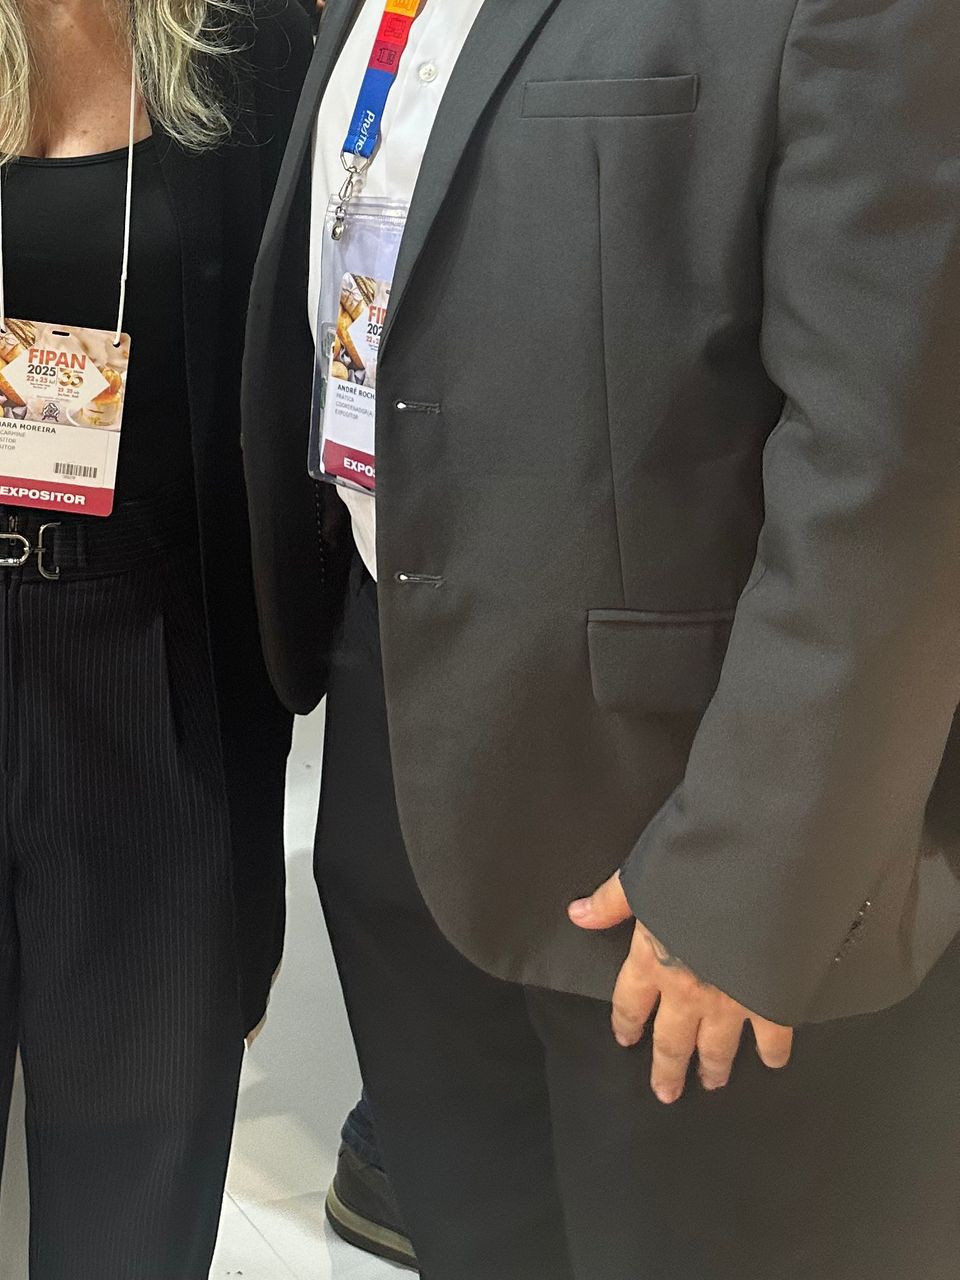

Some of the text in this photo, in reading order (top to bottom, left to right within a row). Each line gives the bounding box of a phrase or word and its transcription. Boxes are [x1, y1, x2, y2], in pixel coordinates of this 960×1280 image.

[28, 348, 87, 370] FIPAN
[27, 363, 56, 377] 2025
[337, 384, 357, 395] ANDRÉ
[19, 423, 57, 434] MOREIRA
[0, 485, 86, 505] EXPOSITOR
